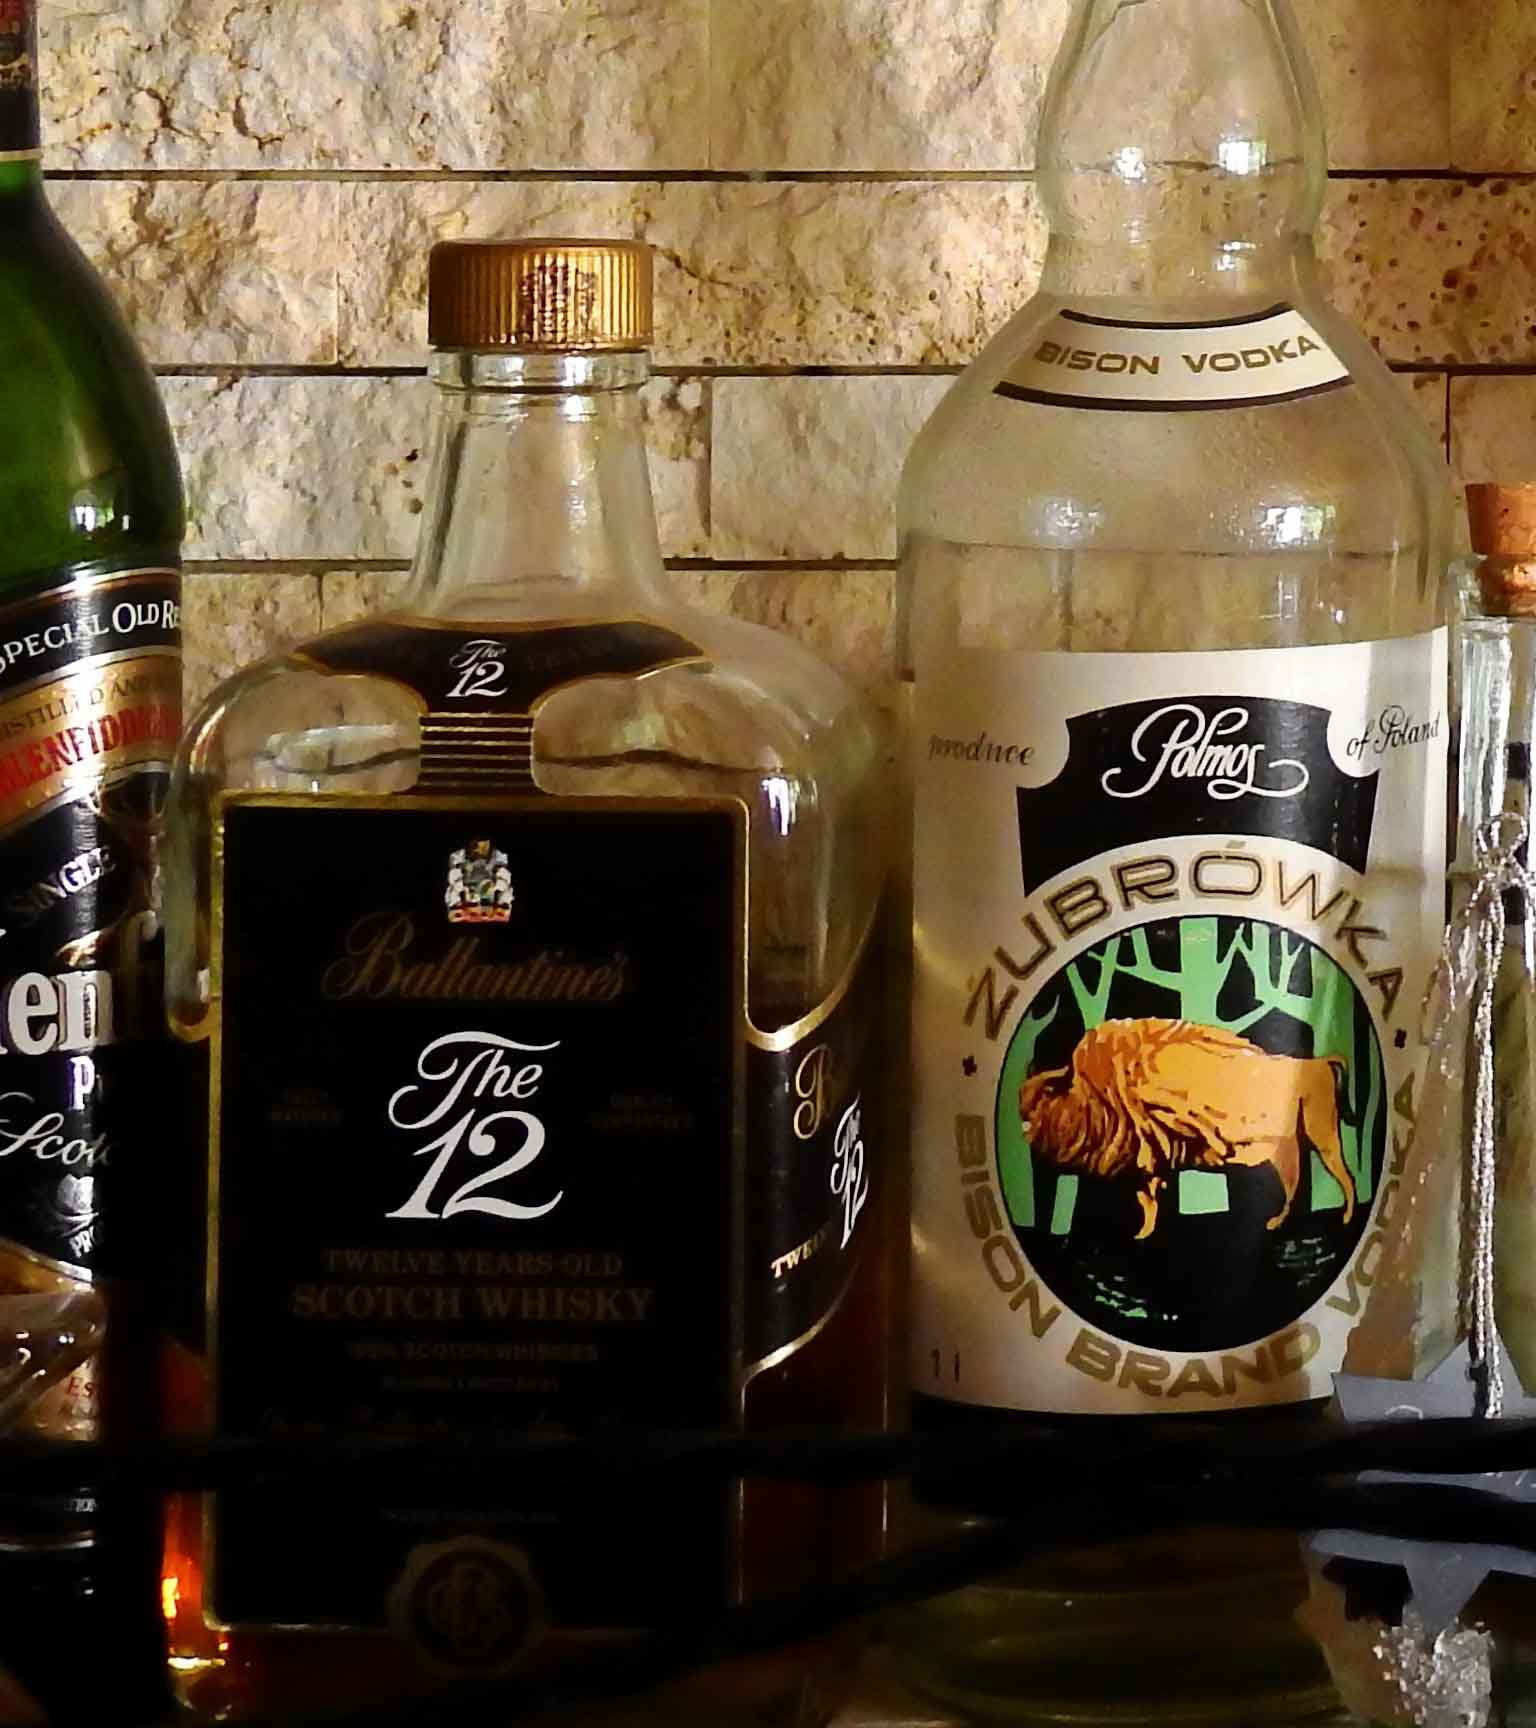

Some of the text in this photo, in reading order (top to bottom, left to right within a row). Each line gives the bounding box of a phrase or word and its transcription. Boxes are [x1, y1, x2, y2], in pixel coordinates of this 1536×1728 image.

[1035, 333, 1321, 375] BISON VODKA
[112, 601, 160, 634] OLD
[449, 637, 510, 670] The
[446, 659, 510, 698] 12
[1101, 703, 1309, 800] Polmos
[1347, 704, 1441, 761] of Poland
[387, 1031, 561, 1130] The
[384, 1109, 564, 1220] 12
[955, 1113, 1062, 1340] BISON
[1065, 1324, 1322, 1398] BRAND
[290, 1285, 656, 1322] SCOTCH WHISKY
